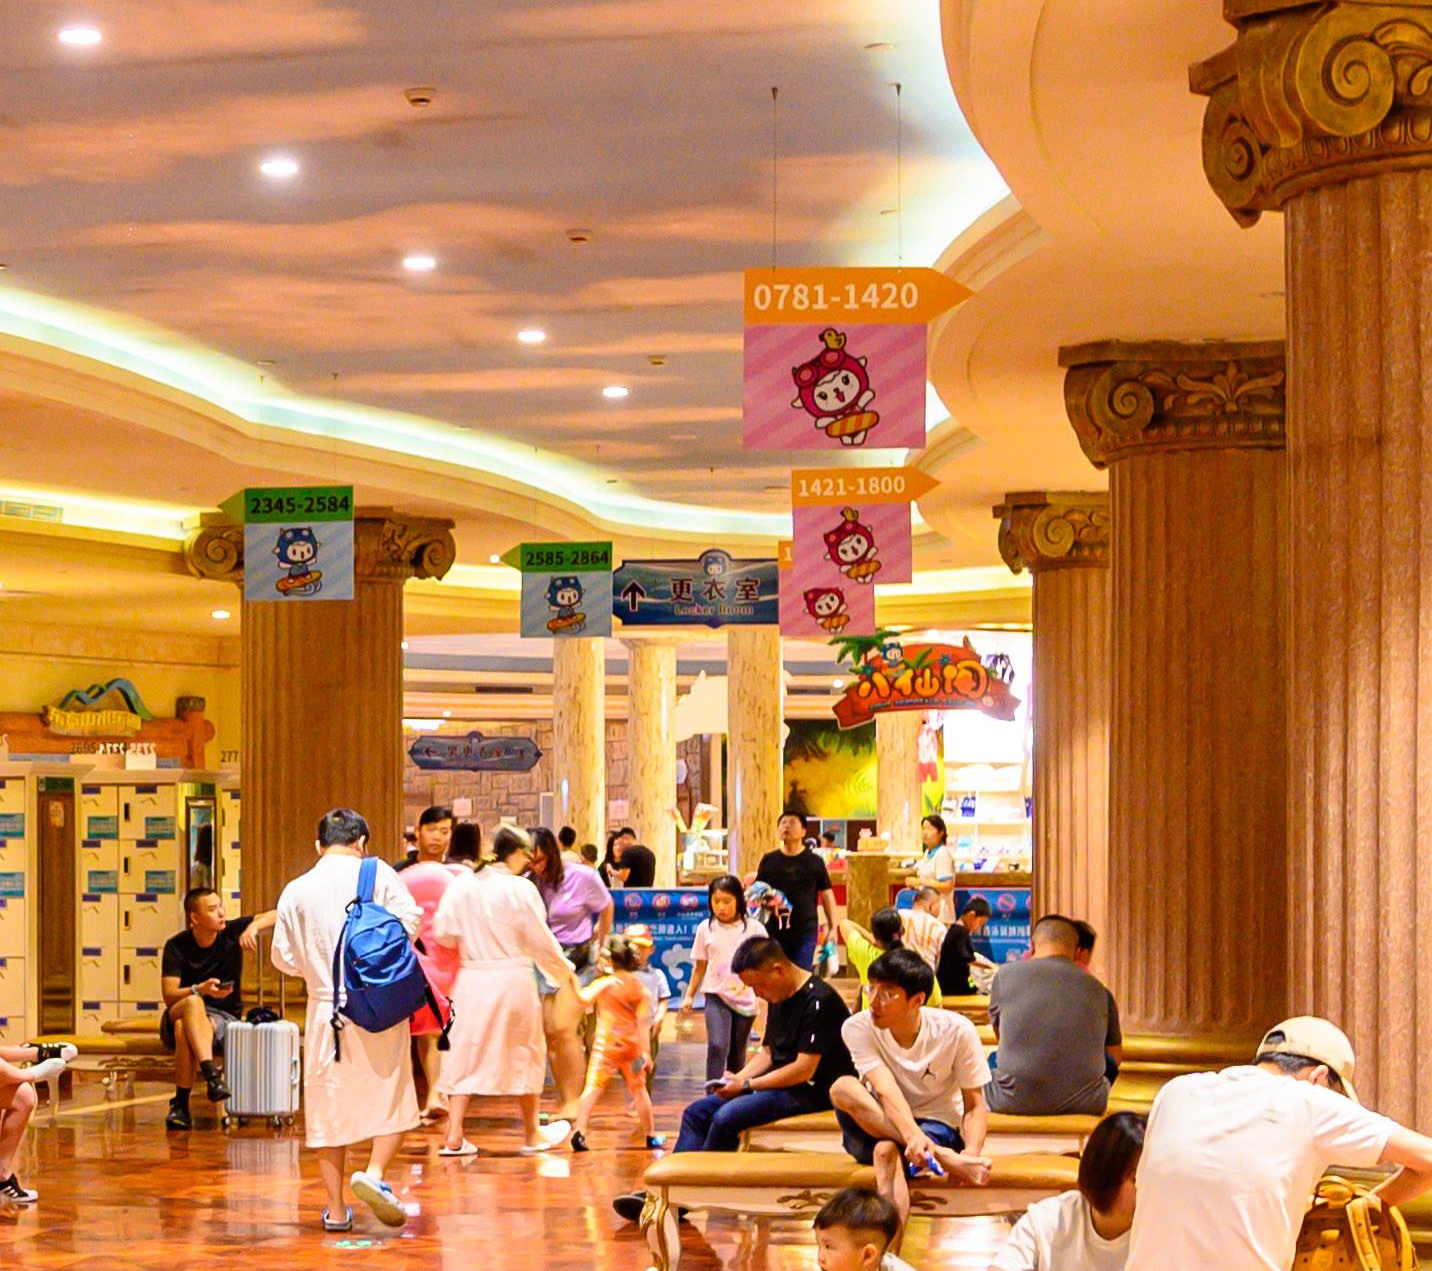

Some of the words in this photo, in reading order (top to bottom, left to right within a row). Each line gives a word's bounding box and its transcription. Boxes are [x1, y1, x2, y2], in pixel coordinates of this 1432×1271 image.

[753, 282, 919, 311] 0781-1420
[798, 476, 906, 498] 1421-1800
[250, 494, 350, 516] 2345-2584
[526, 550, 609, 567] 2585-2864
[670, 577, 760, 602] 更衣室
